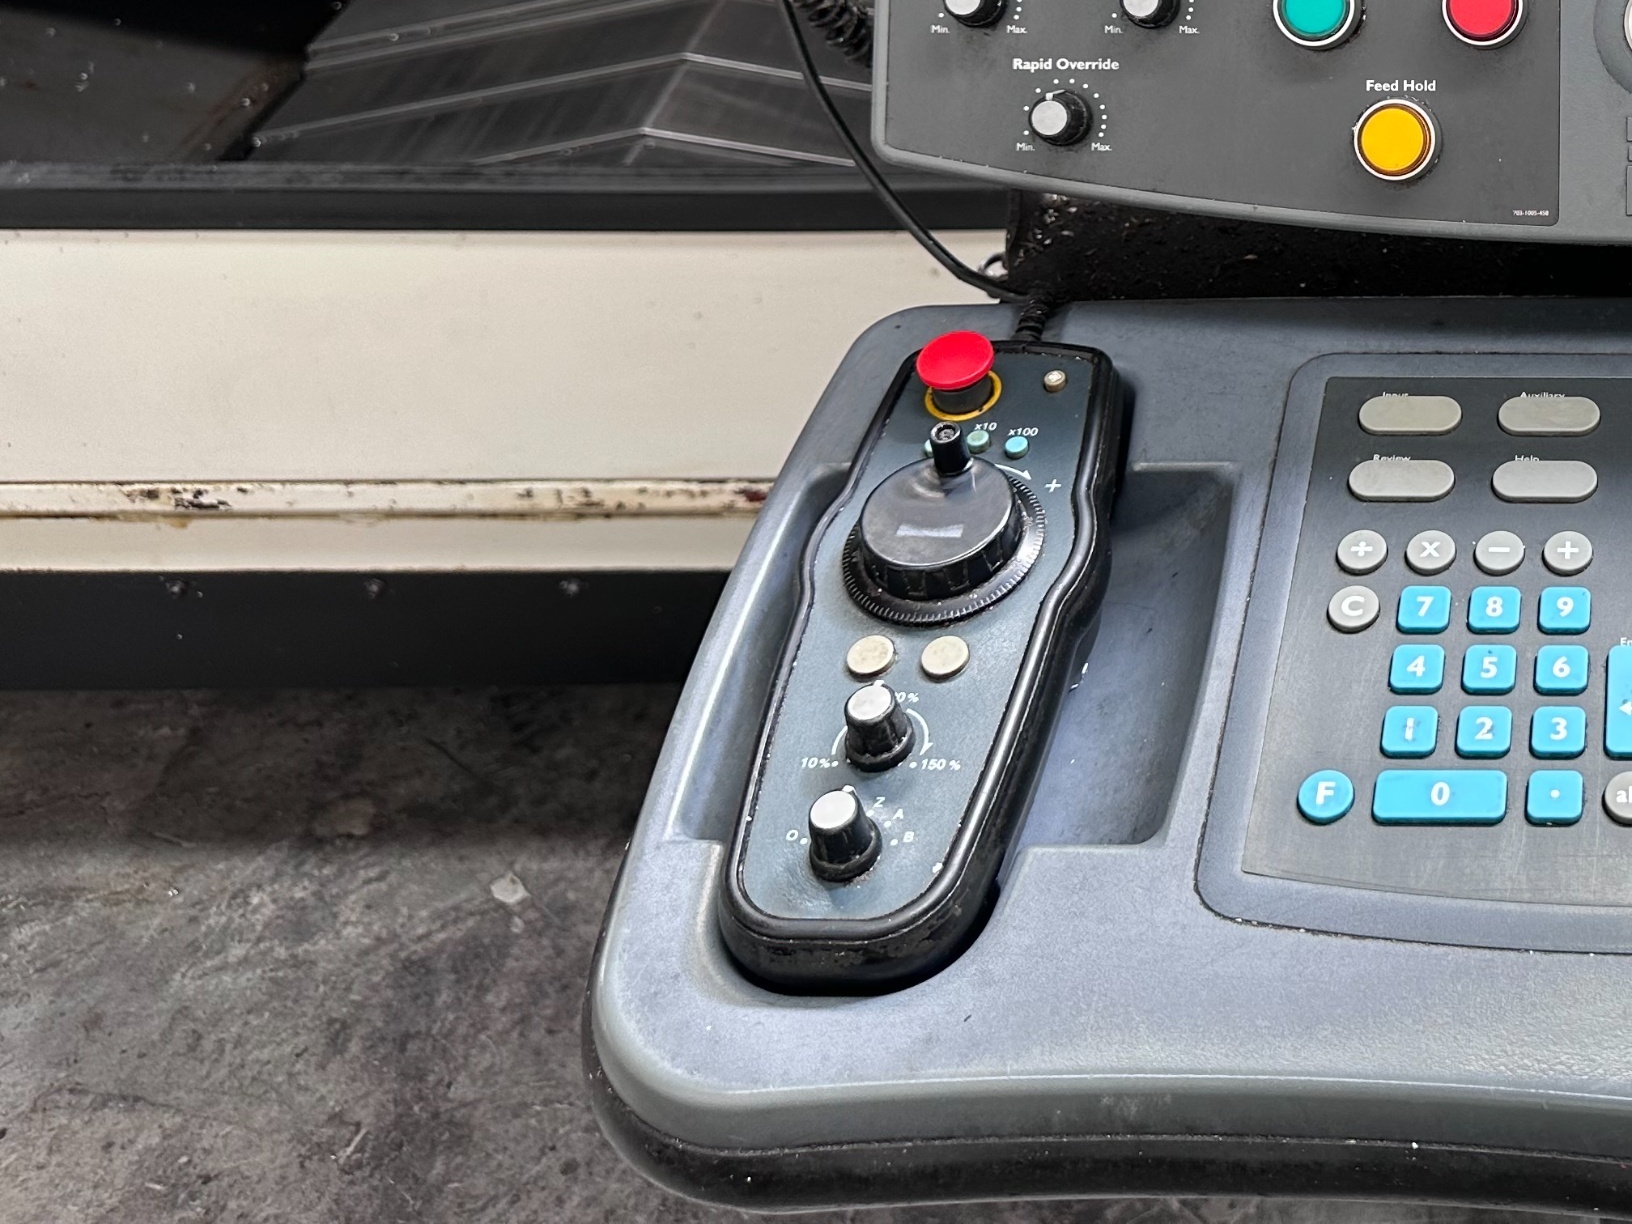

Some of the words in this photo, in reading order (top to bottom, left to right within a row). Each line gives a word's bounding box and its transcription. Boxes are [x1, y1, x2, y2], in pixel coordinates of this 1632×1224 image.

[930, 24, 949, 33] Min.
[1006, 24, 1027, 33] Max.
[1104, 24, 1122, 33] Min.
[1178, 25, 1199, 33] Max.
[1012, 57, 1052, 73] Rapid
[1055, 57, 1119, 70] Override
[1365, 79, 1398, 91] Feed
[1403, 79, 1435, 91] Hold
[1016, 142, 1034, 151] Min.
[1091, 142, 1112, 151] Max.
[1340, 595, 1365, 617] C
[1416, 595, 1434, 617] 7
[1485, 595, 1503, 617] 8
[1556, 596, 1574, 617] 9
[1406, 654, 1425, 677] 4
[1480, 655, 1498, 678] 5
[1552, 655, 1570, 677] 6
[1474, 716, 1493, 740] 2
[1549, 716, 1567, 740] 3
[1315, 780, 1336, 806] F
[1430, 781, 1450, 806] 0
[893, 808, 904, 819] A
[903, 832, 914, 842] B
